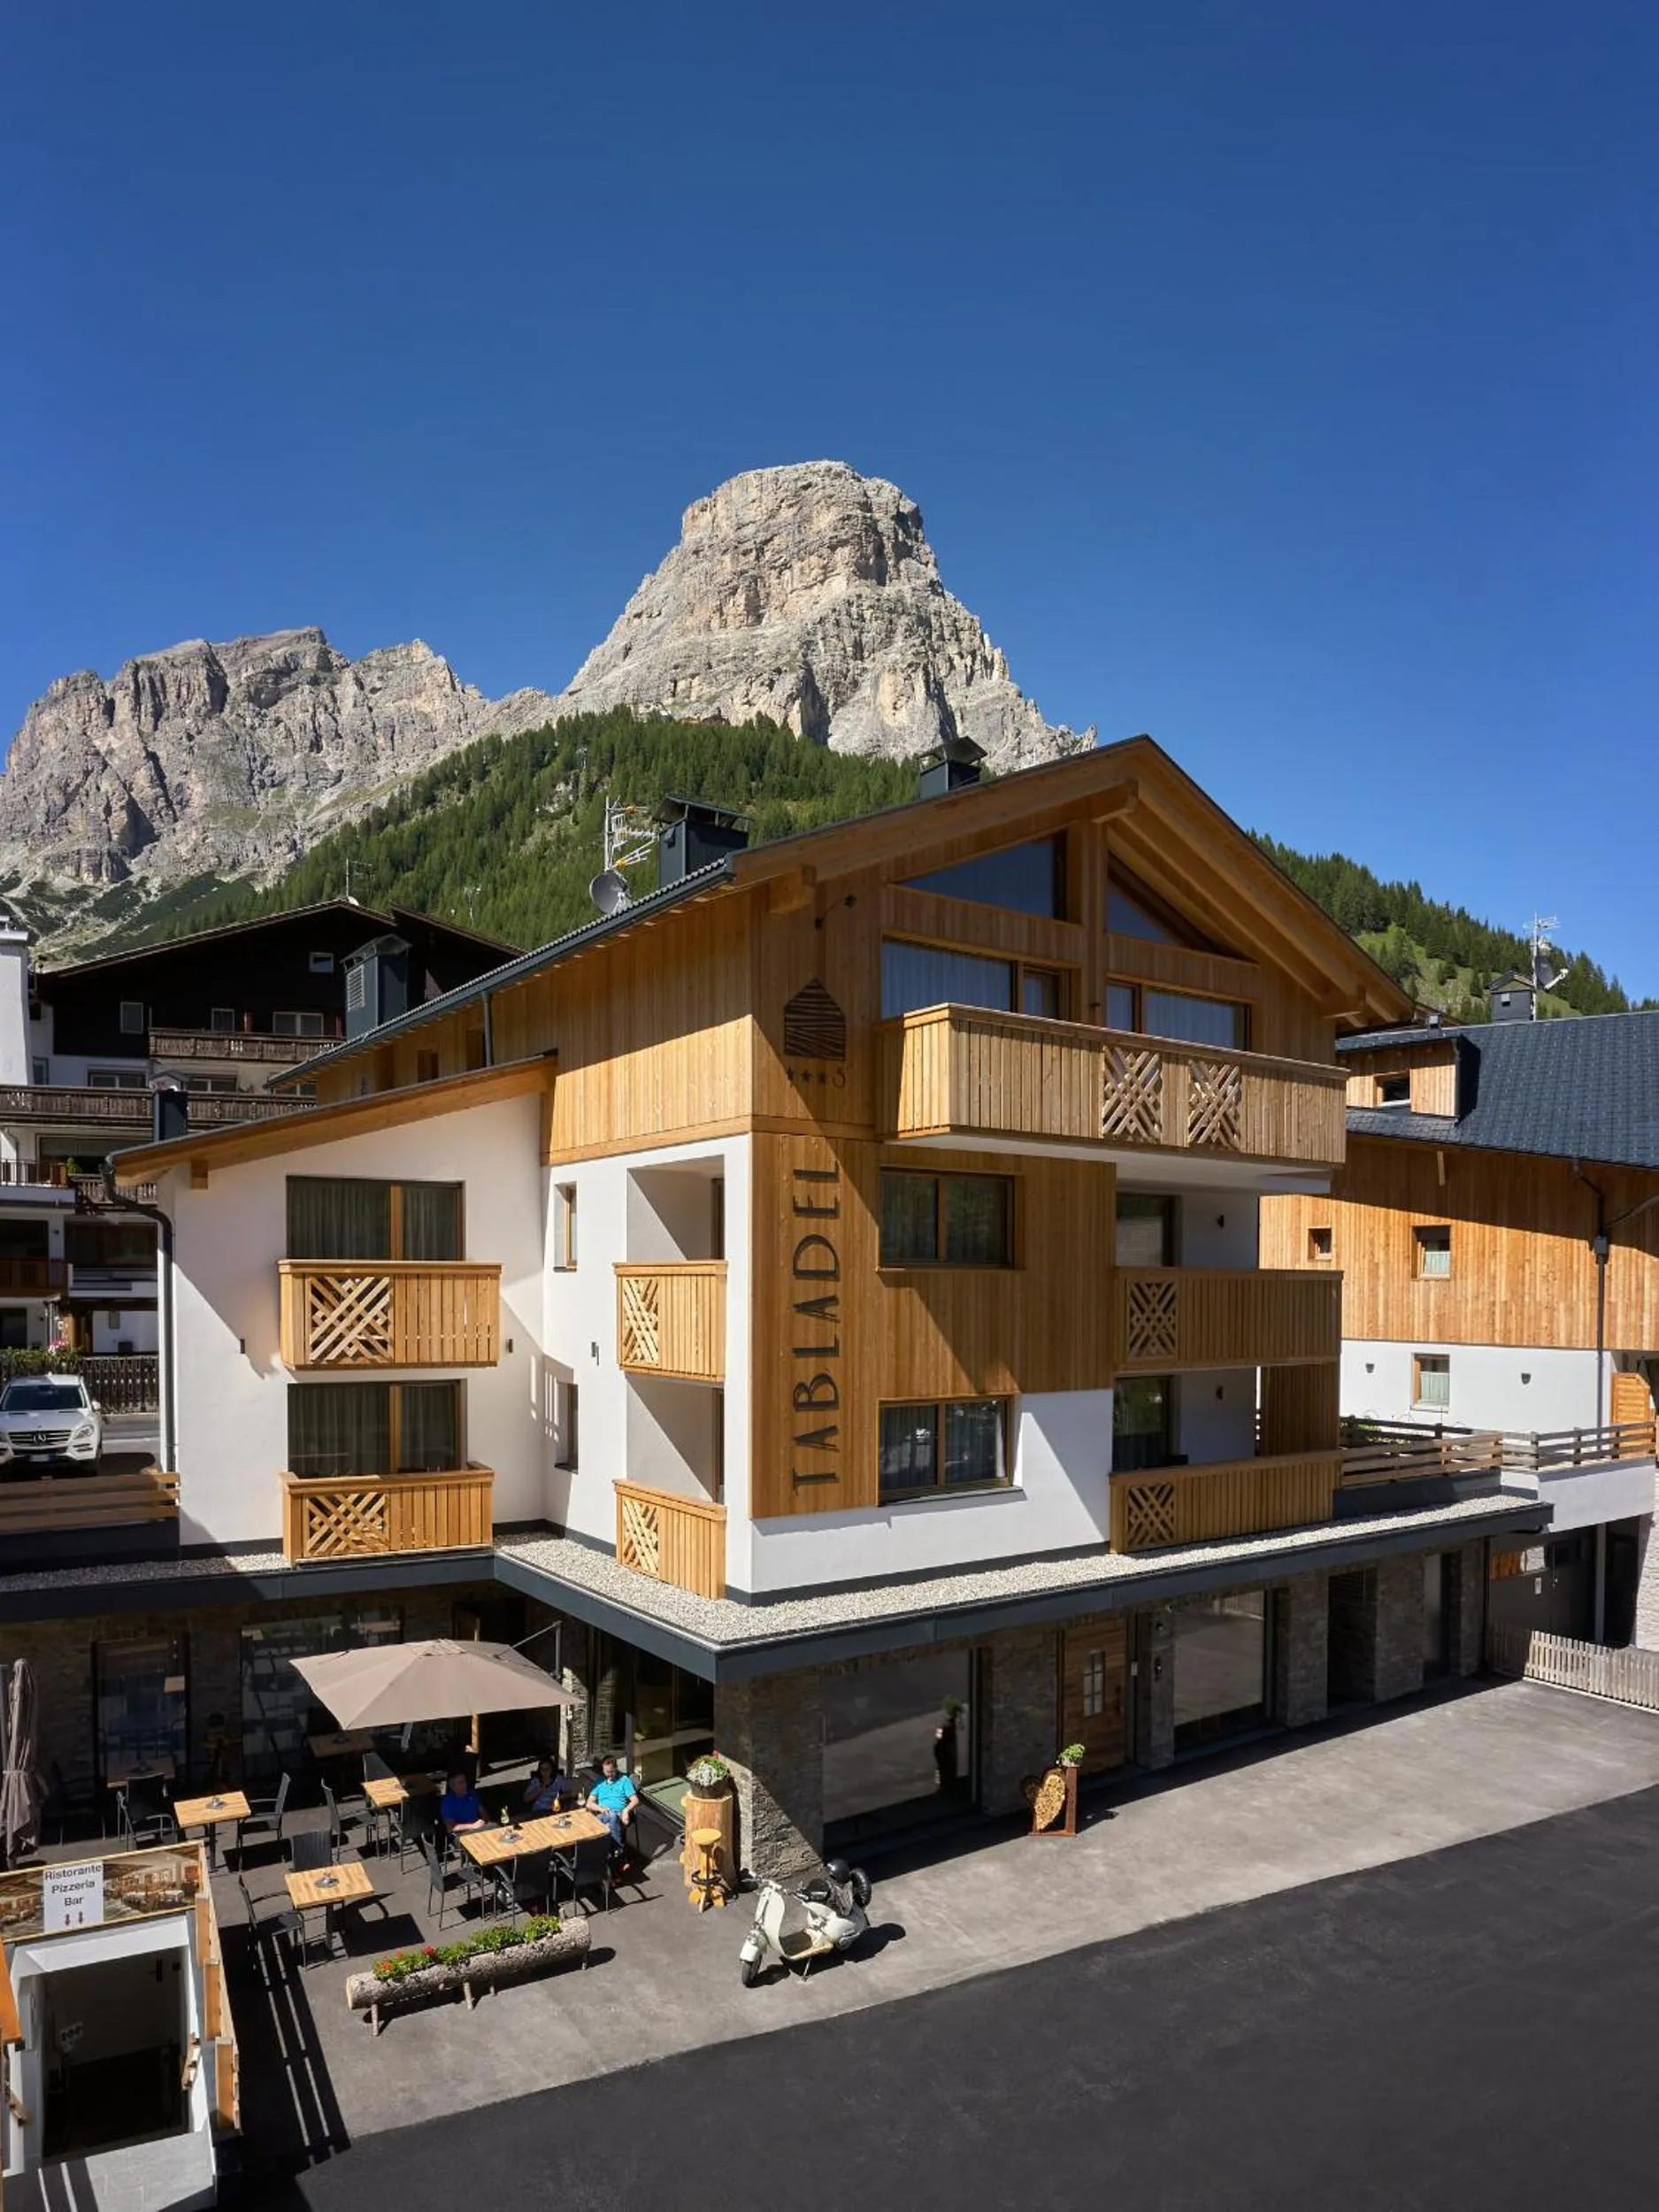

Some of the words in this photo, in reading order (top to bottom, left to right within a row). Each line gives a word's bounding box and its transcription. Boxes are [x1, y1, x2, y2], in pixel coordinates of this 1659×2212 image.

[793, 1157, 840, 1495] TABLADEL
[45, 1865, 102, 1879] Ristorante
[51, 1879, 96, 1893] Pizzeria
[64, 1897, 84, 1906] Bar
